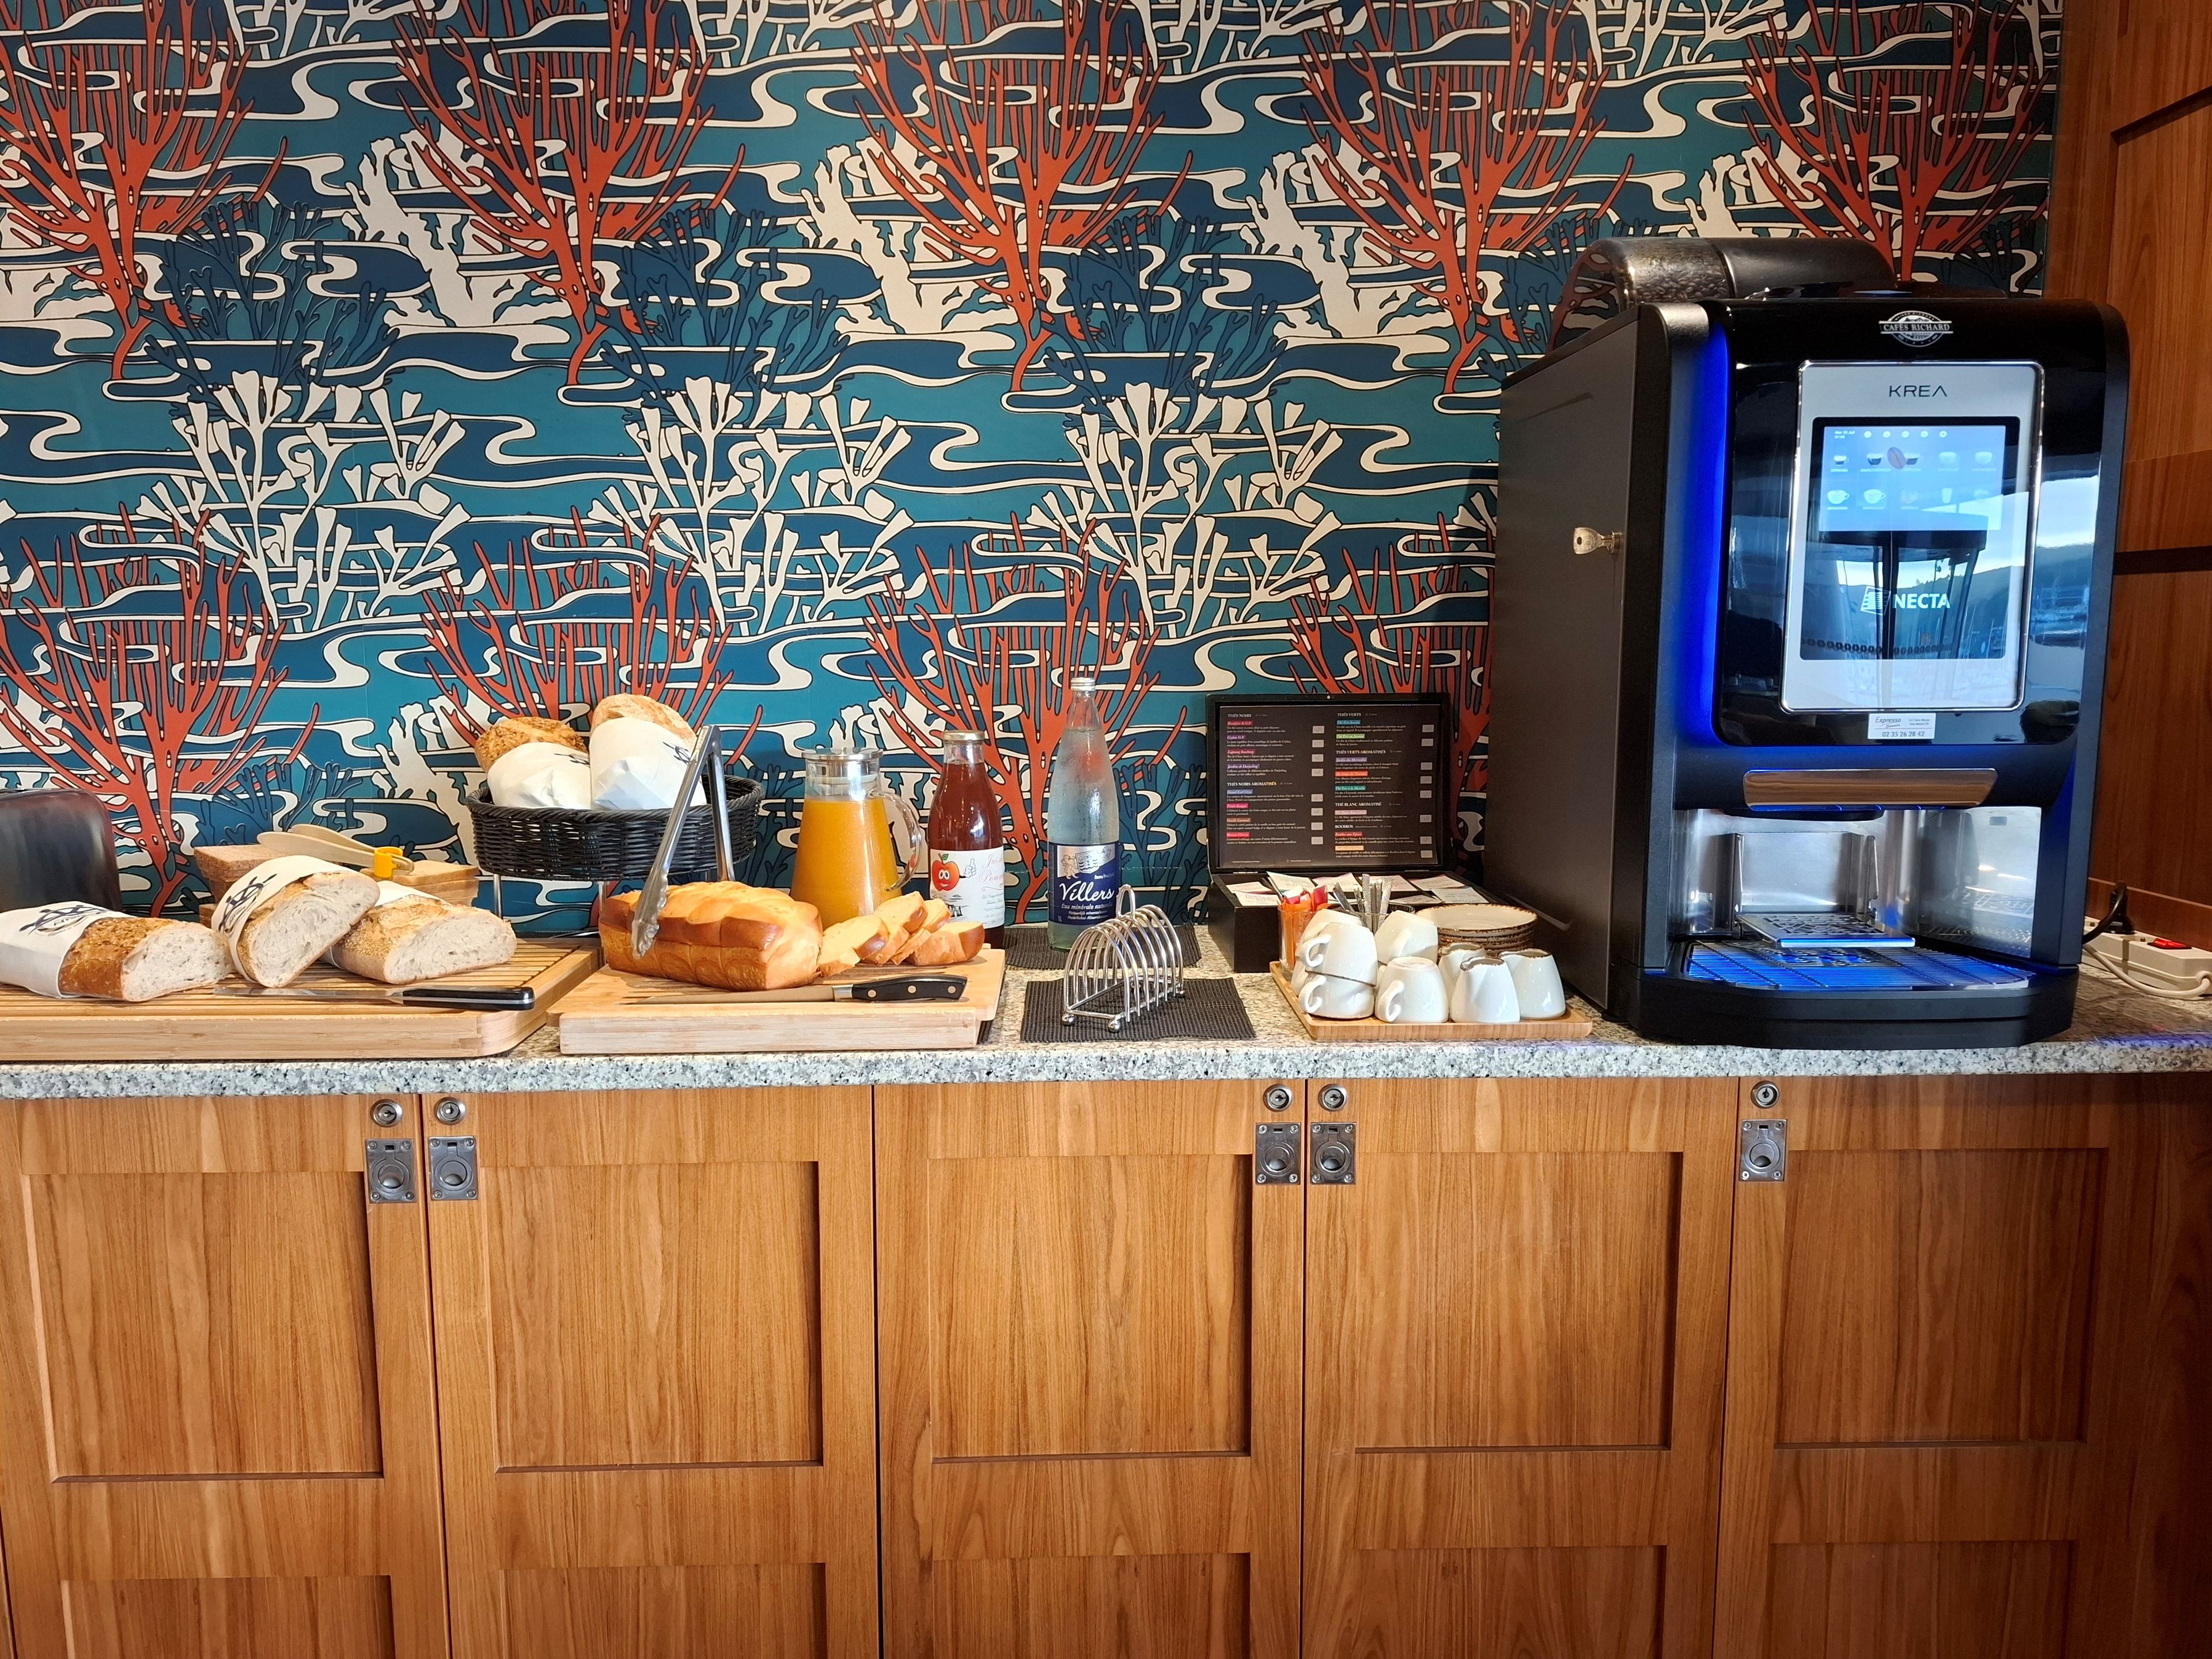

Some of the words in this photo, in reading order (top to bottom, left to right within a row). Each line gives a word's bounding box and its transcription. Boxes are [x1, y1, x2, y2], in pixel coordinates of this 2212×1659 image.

[1889, 385, 1948, 397] KREA
[1893, 593, 1950, 609] NECTA
[1059, 880, 1115, 902] Villers
